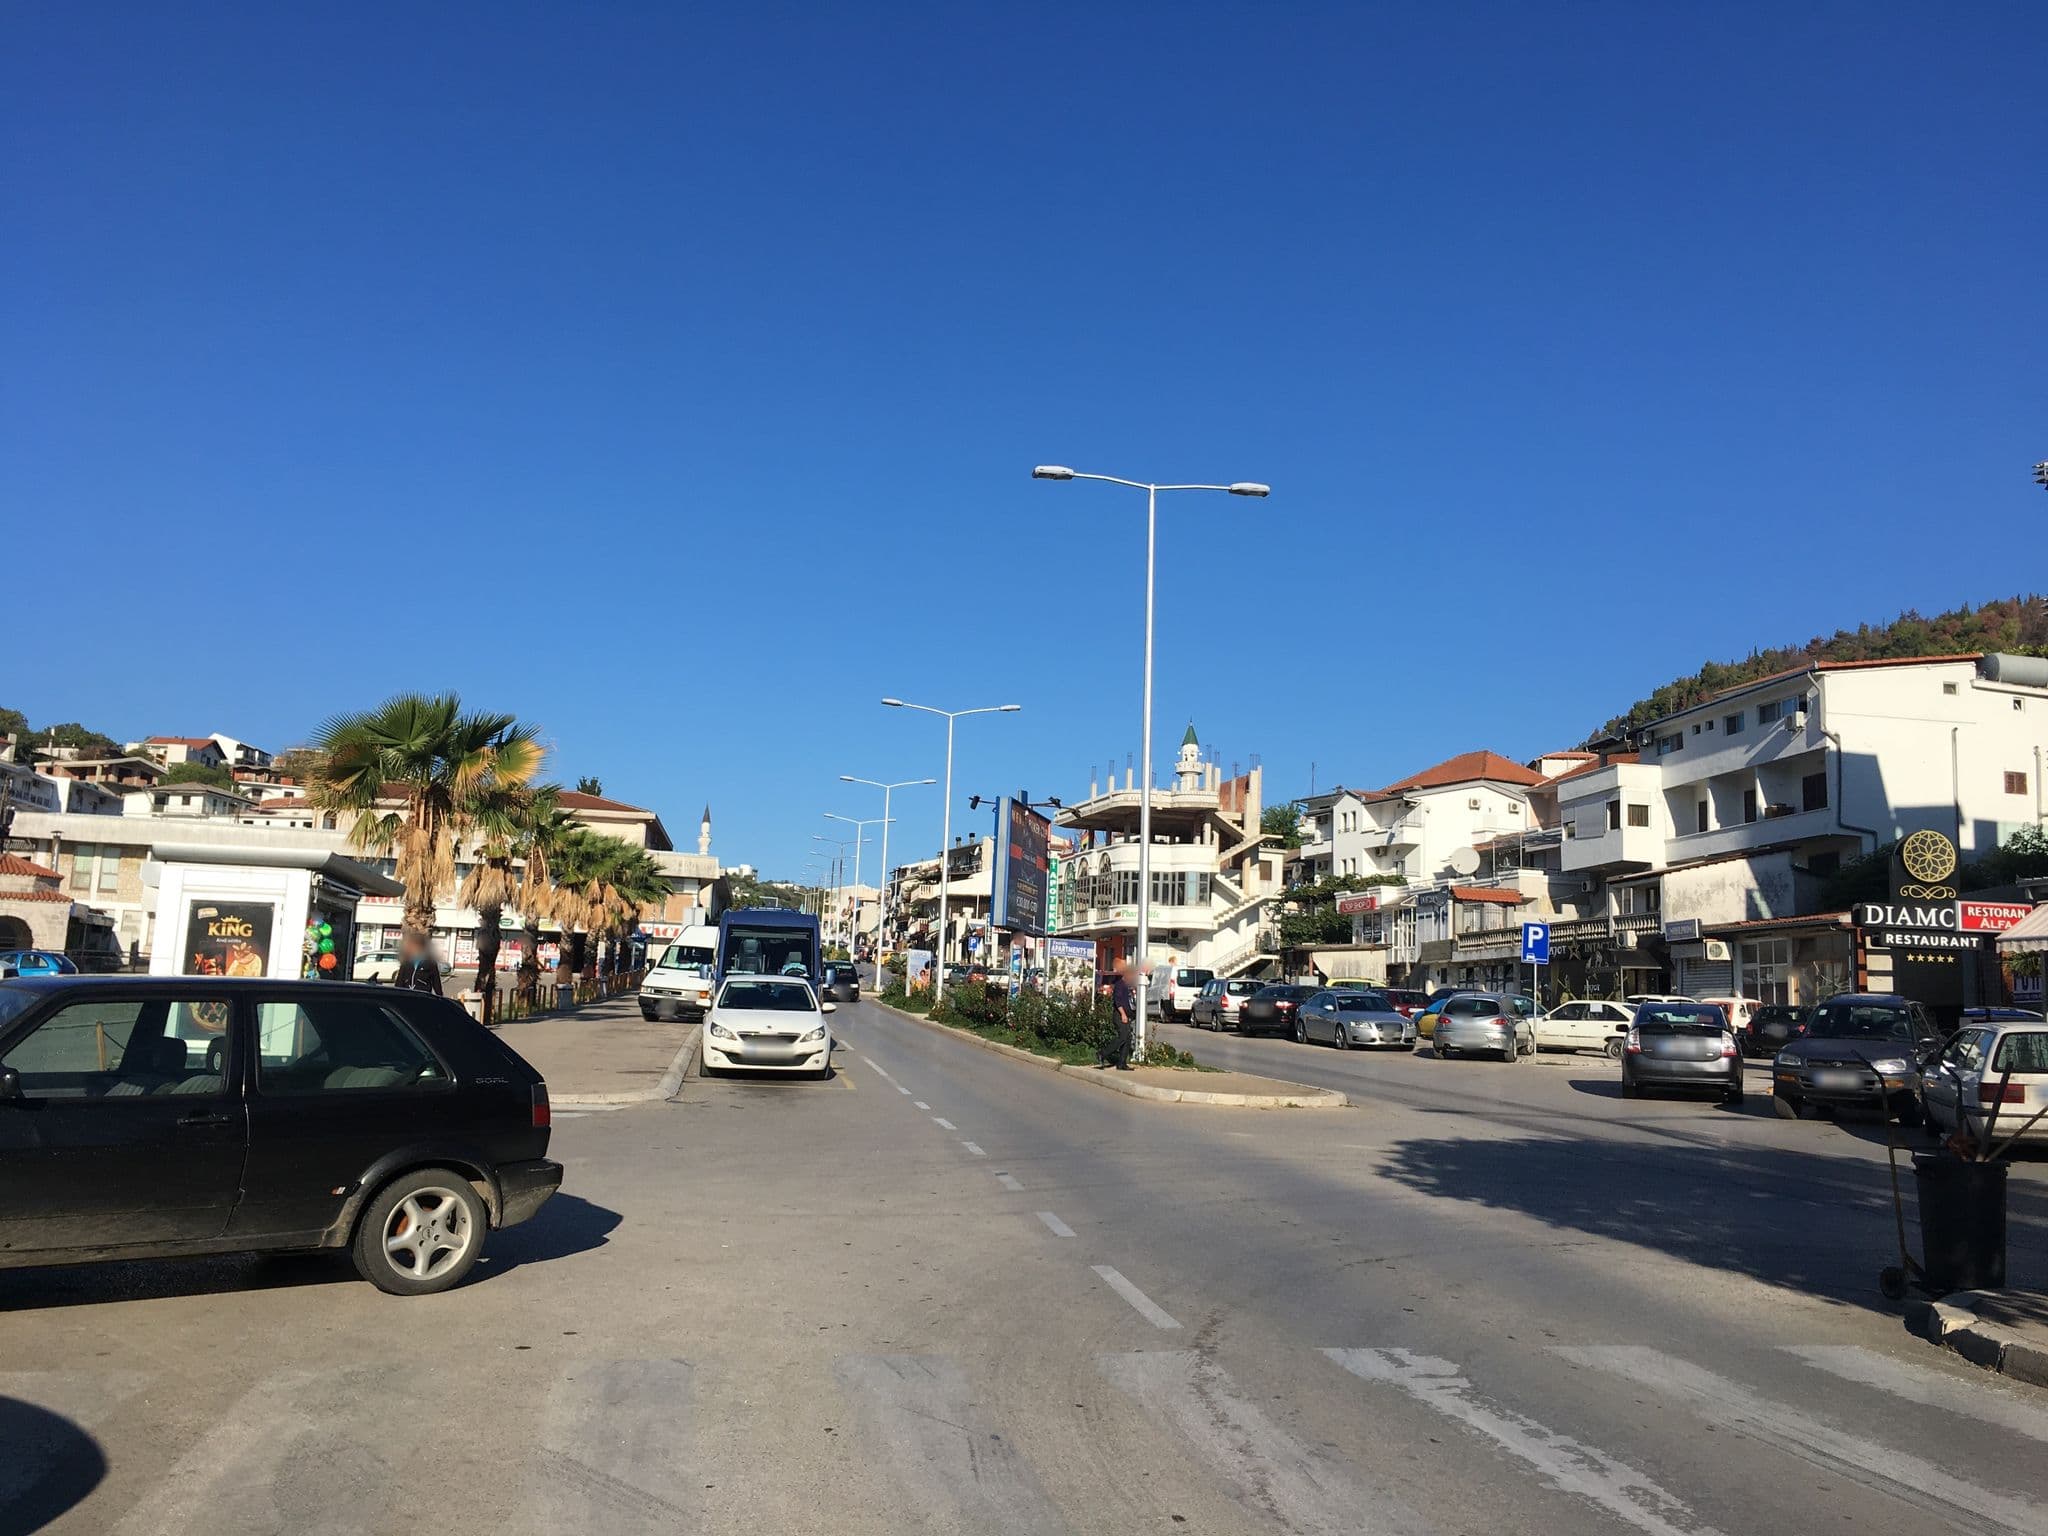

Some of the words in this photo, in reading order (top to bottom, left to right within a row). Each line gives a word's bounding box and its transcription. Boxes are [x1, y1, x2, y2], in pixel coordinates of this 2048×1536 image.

[1048, 871, 1057, 927] APOTEKA
[1967, 906, 2025, 918] RESTORAN
[207, 921, 253, 937] KING
[1980, 918, 2012, 929] ALFA
[1528, 926, 1544, 948] P
[1886, 933, 1979, 947] RESTAURANT
